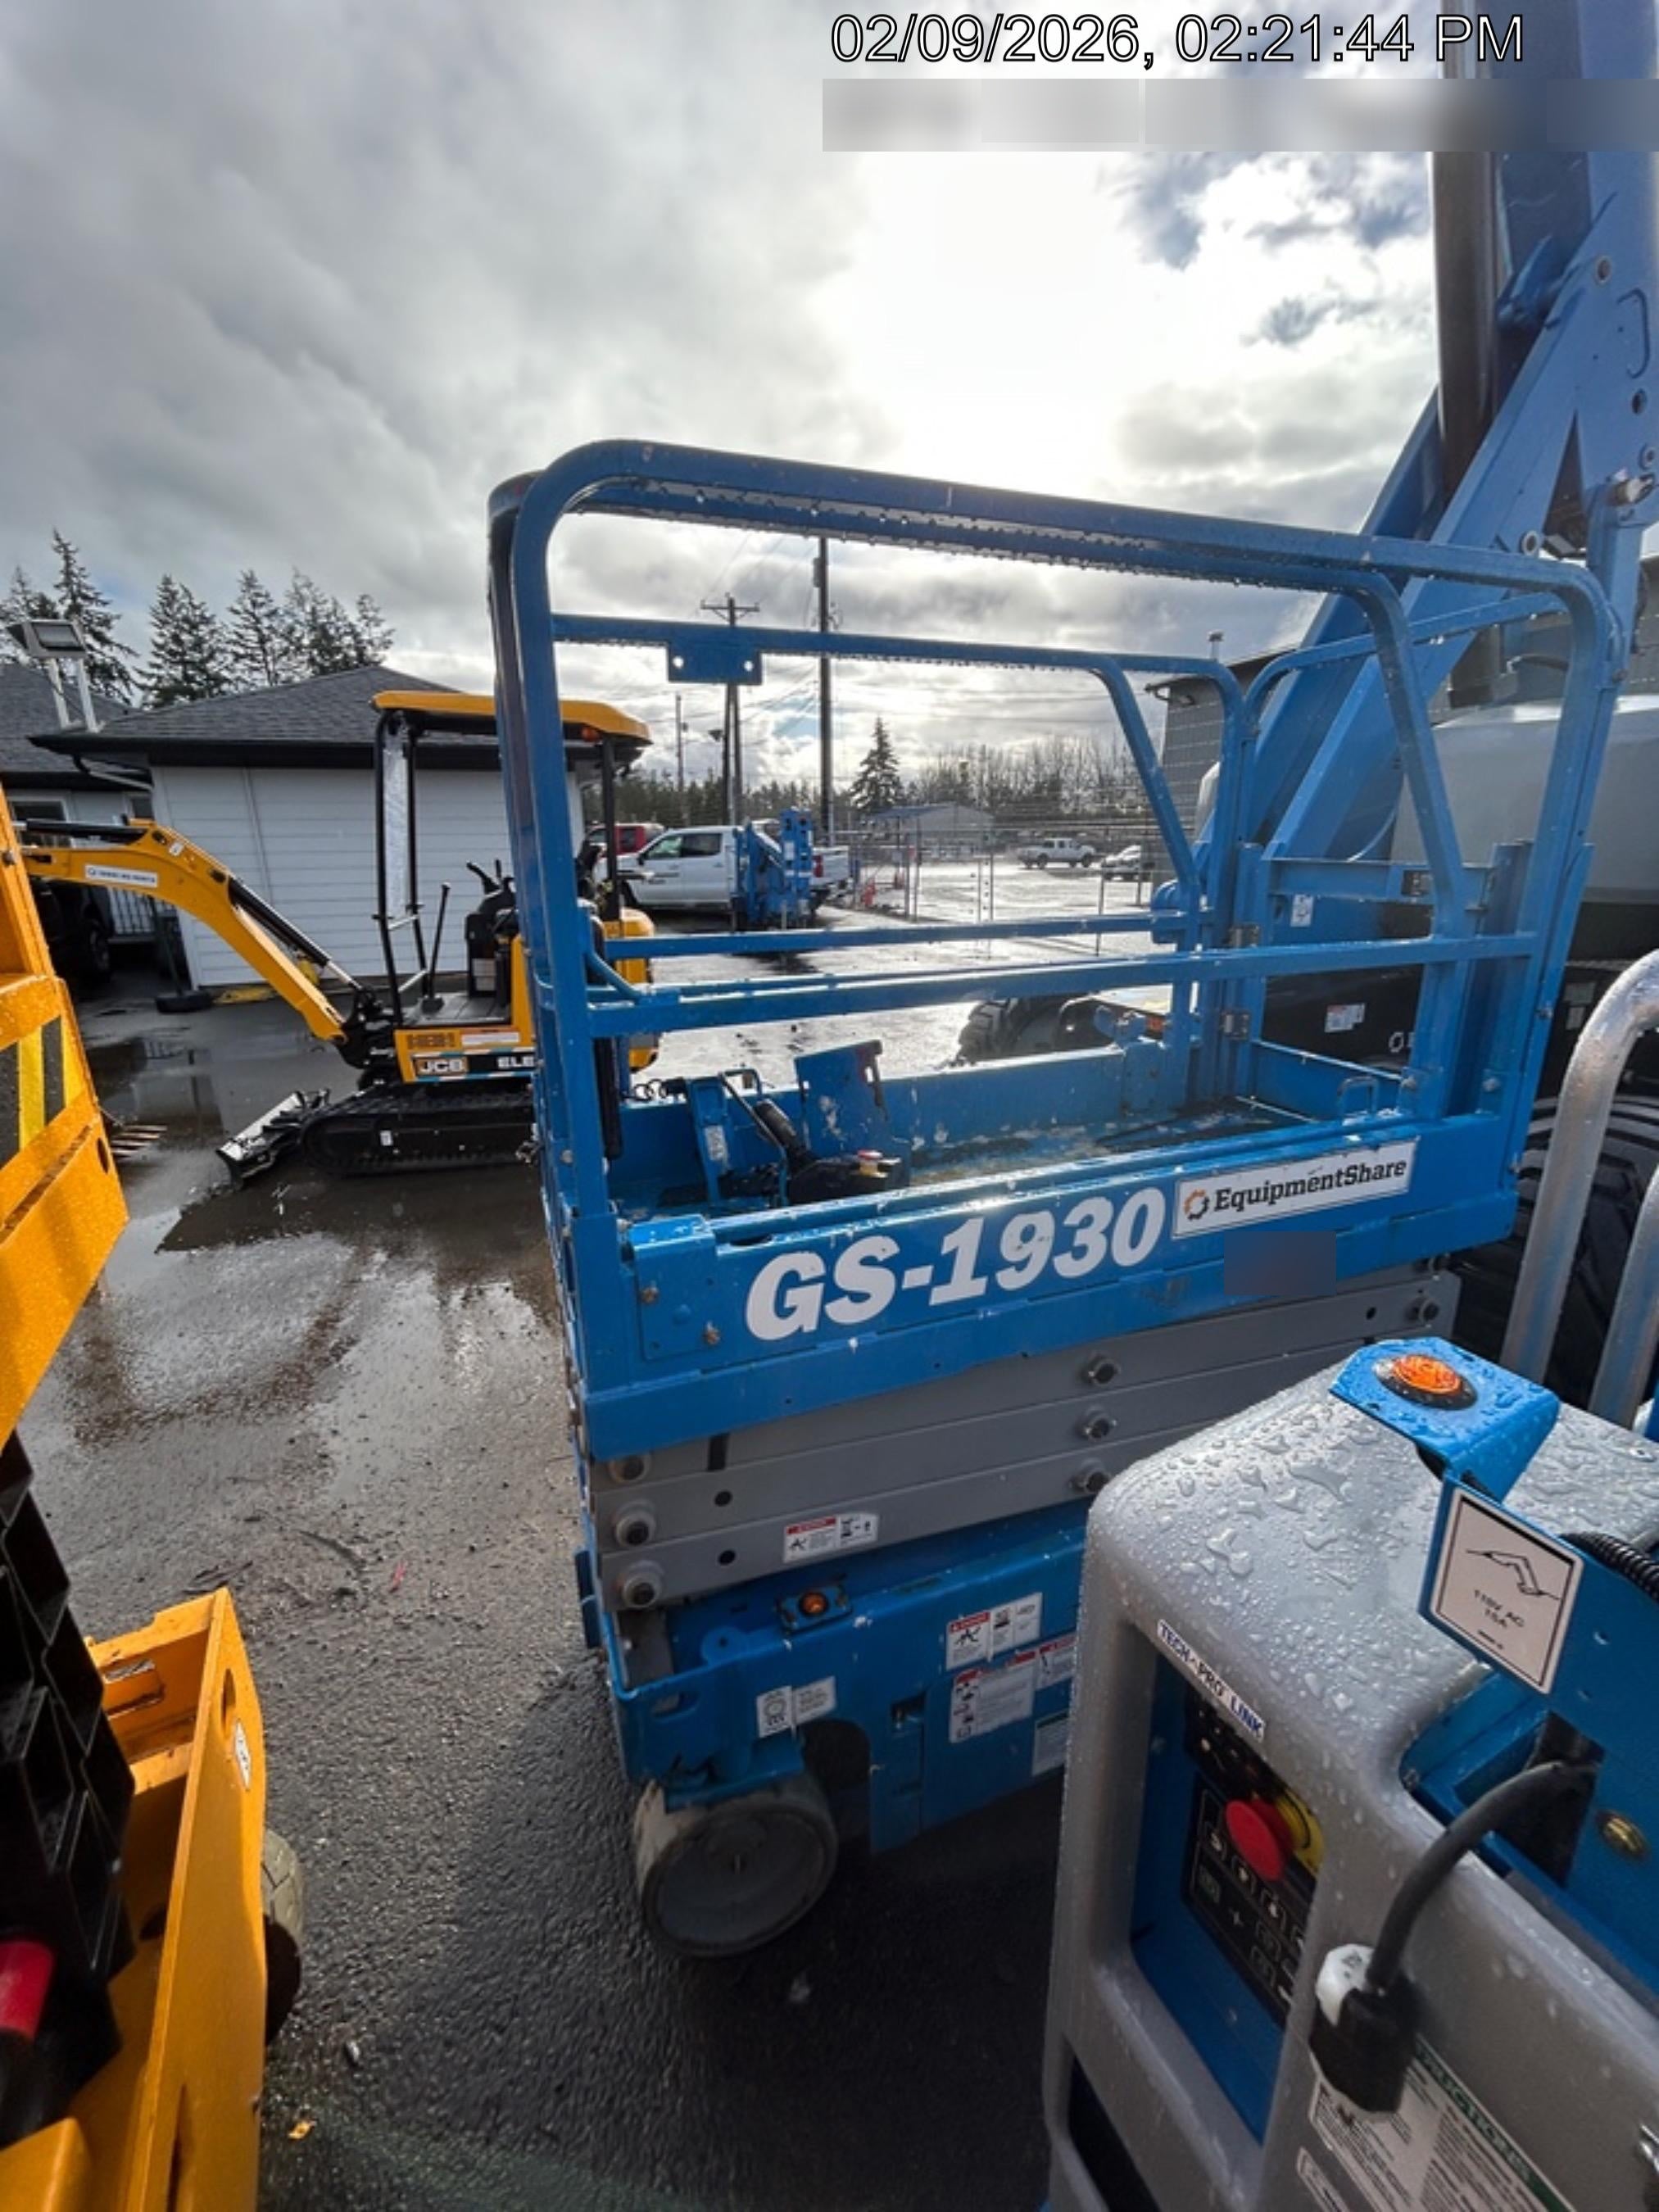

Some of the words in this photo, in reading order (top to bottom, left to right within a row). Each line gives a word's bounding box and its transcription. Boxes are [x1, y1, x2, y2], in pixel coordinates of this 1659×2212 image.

[419, 1058, 464, 1073] JCB
[1213, 1159, 1407, 1213] EquipmentShare
[746, 1188, 1167, 1341] GS-1930
